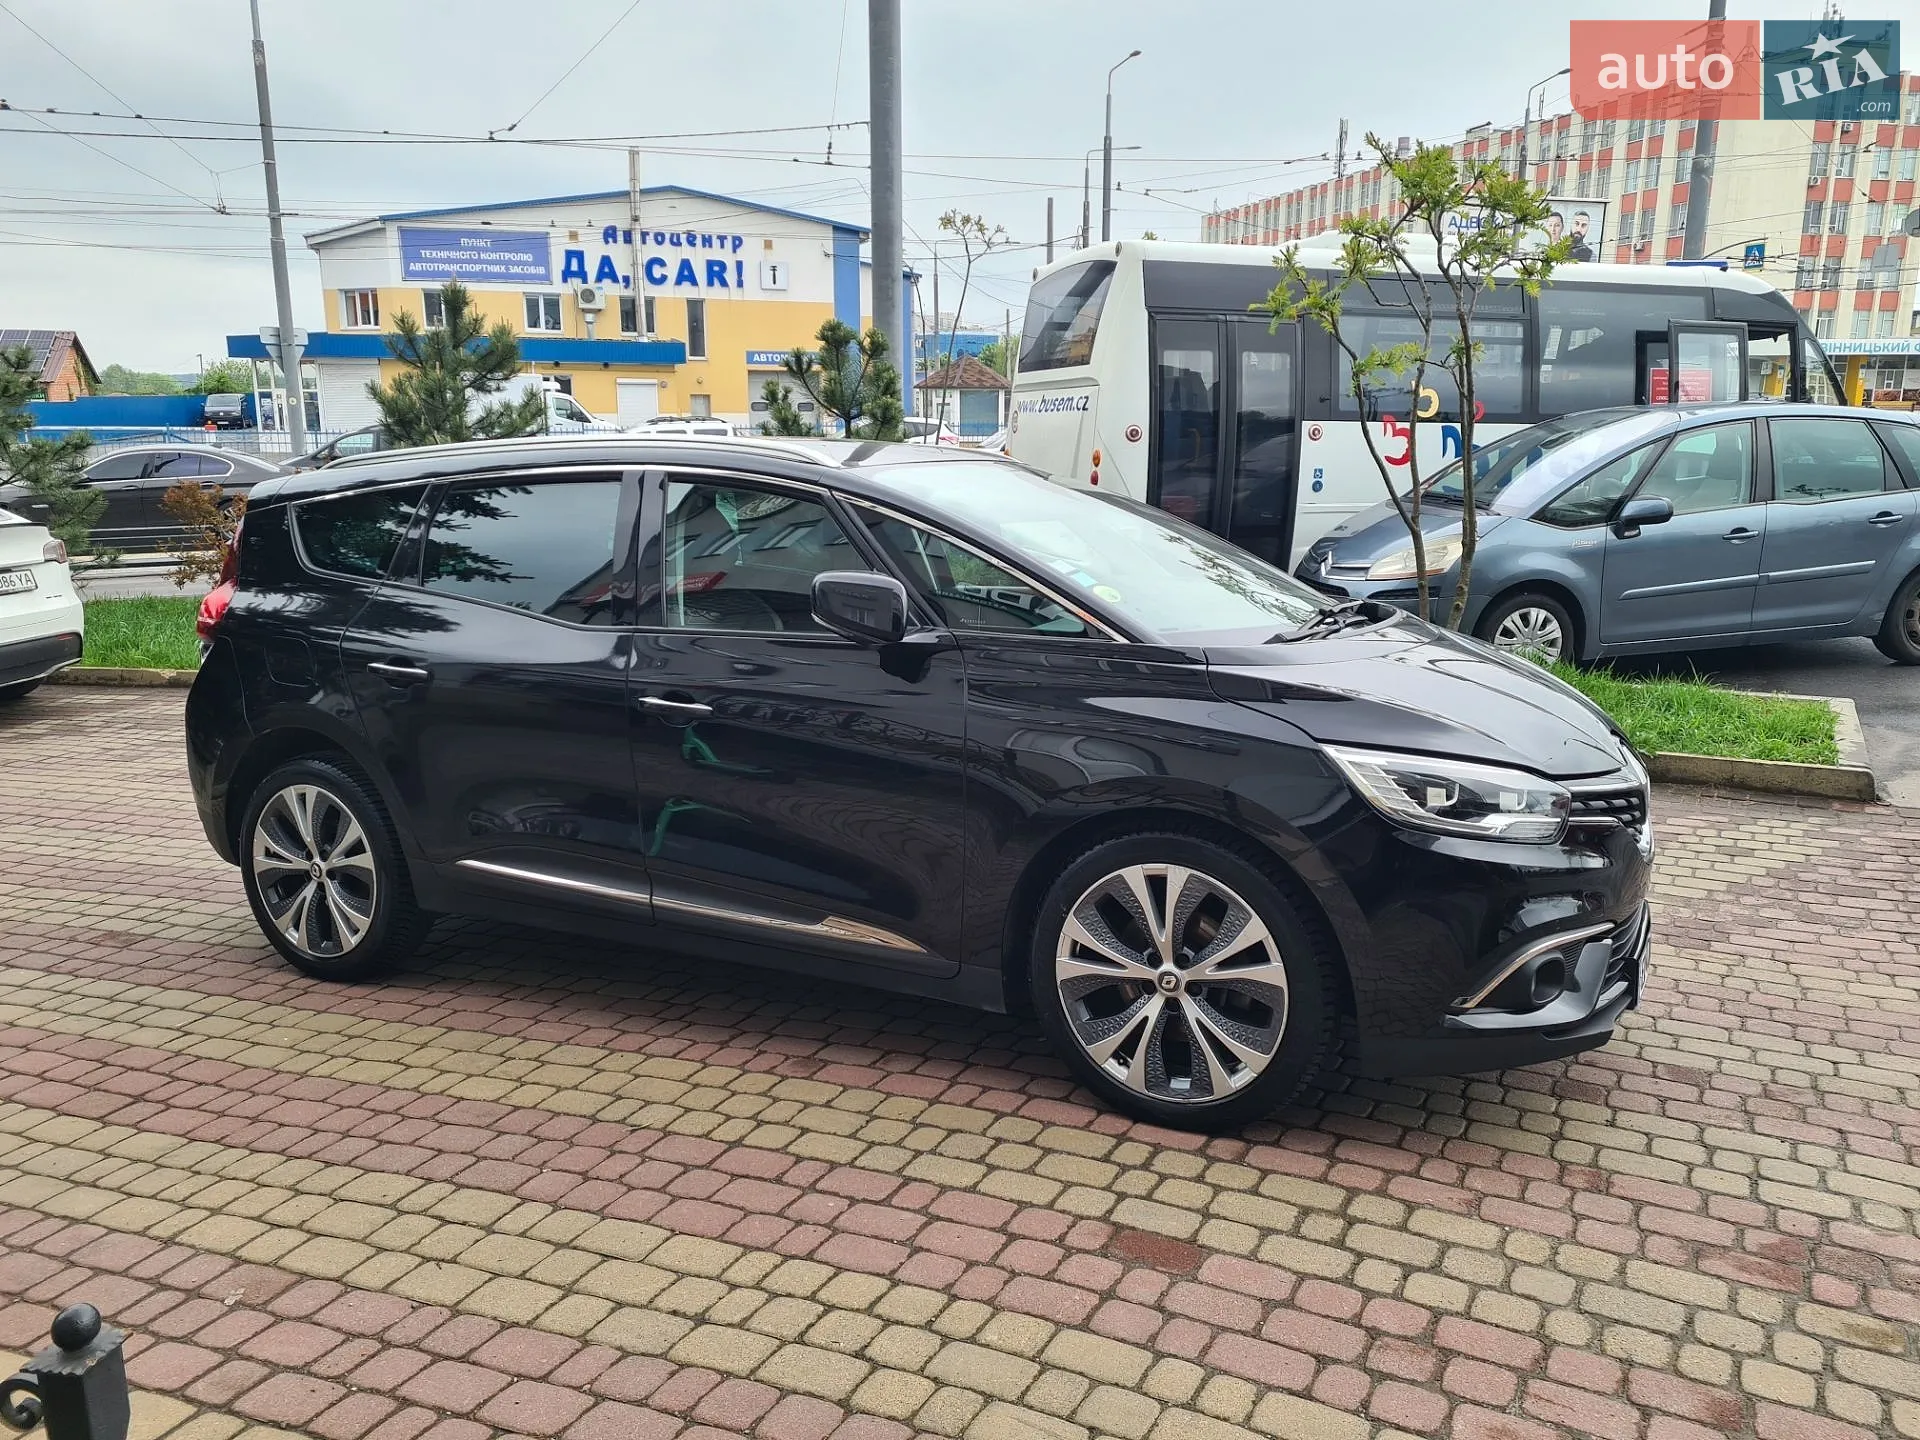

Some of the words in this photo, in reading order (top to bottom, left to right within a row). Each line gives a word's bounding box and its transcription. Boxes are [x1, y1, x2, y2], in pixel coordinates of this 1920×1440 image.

[460, 238, 492, 247] ПУНКТ
[419, 249, 479, 260] ТЕХНІЧНОГО
[480, 252, 533, 262] КОНТРОЛЮ
[409, 262, 507, 273] АВТОТРАНСПОРТНИХ
[508, 265, 546, 275] ЗАСОБІВ
[644, 256, 744, 288] CAR!
[1018, 394, 1090, 413] www.busem.cz
